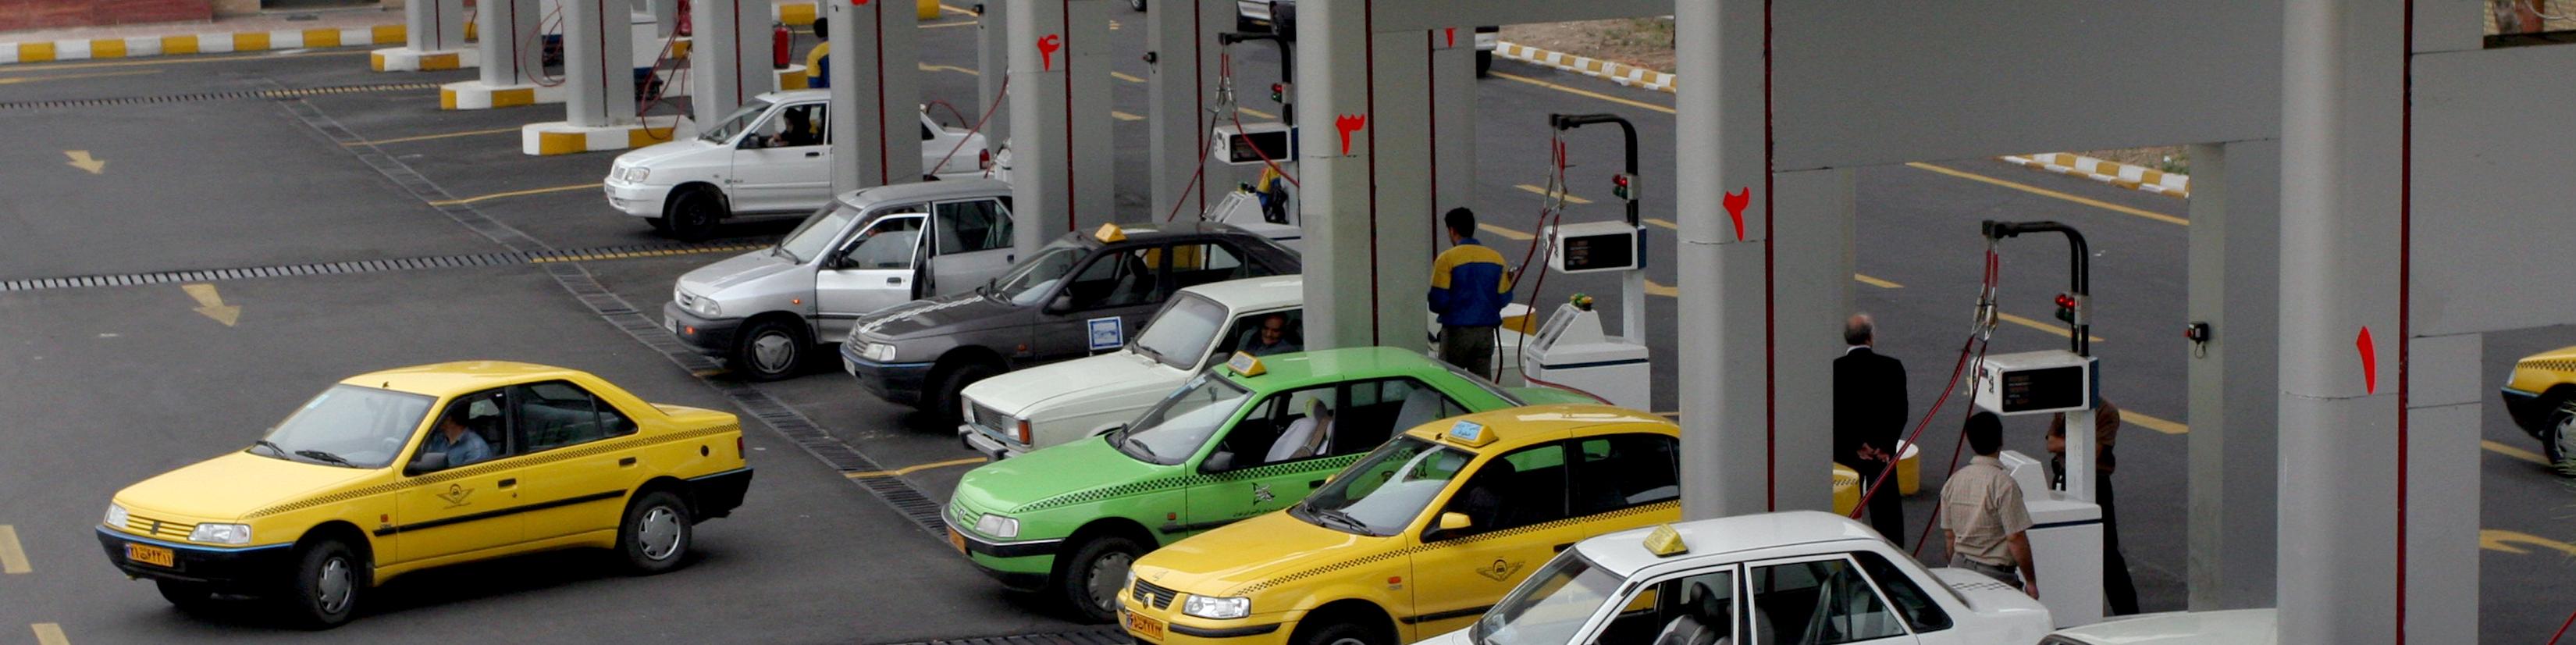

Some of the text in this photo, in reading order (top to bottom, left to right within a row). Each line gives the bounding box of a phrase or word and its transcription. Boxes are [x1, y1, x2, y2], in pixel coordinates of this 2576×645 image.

[1037, 34, 1060, 71] ۴
[1336, 114, 1365, 155] ۳
[1722, 187, 1750, 242] ۲
[2357, 326, 2376, 394] ۱
